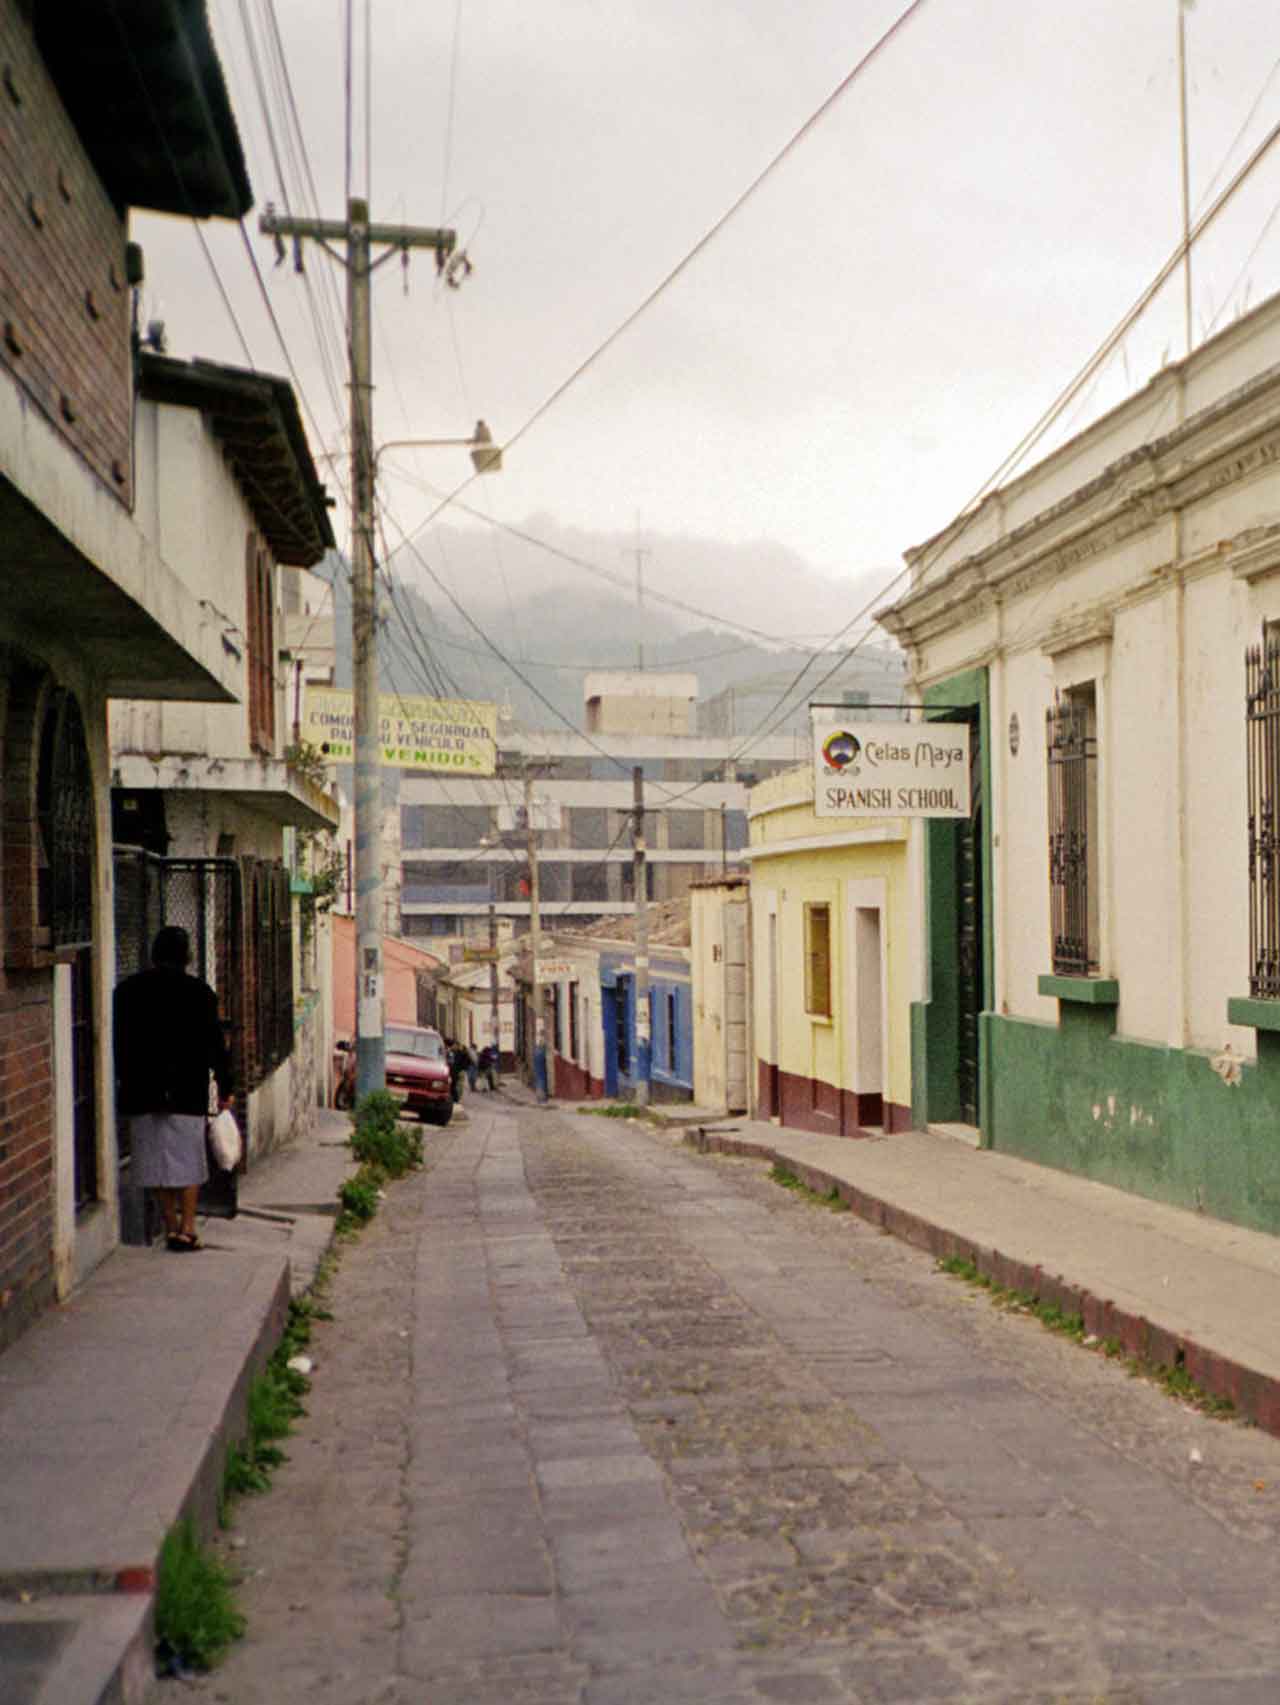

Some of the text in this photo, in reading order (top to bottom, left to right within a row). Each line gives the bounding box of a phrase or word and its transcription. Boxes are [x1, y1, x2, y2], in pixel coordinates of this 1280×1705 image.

[865, 742, 964, 768] Celas Maya
[825, 787, 961, 811] SPANISH SCHOOL
